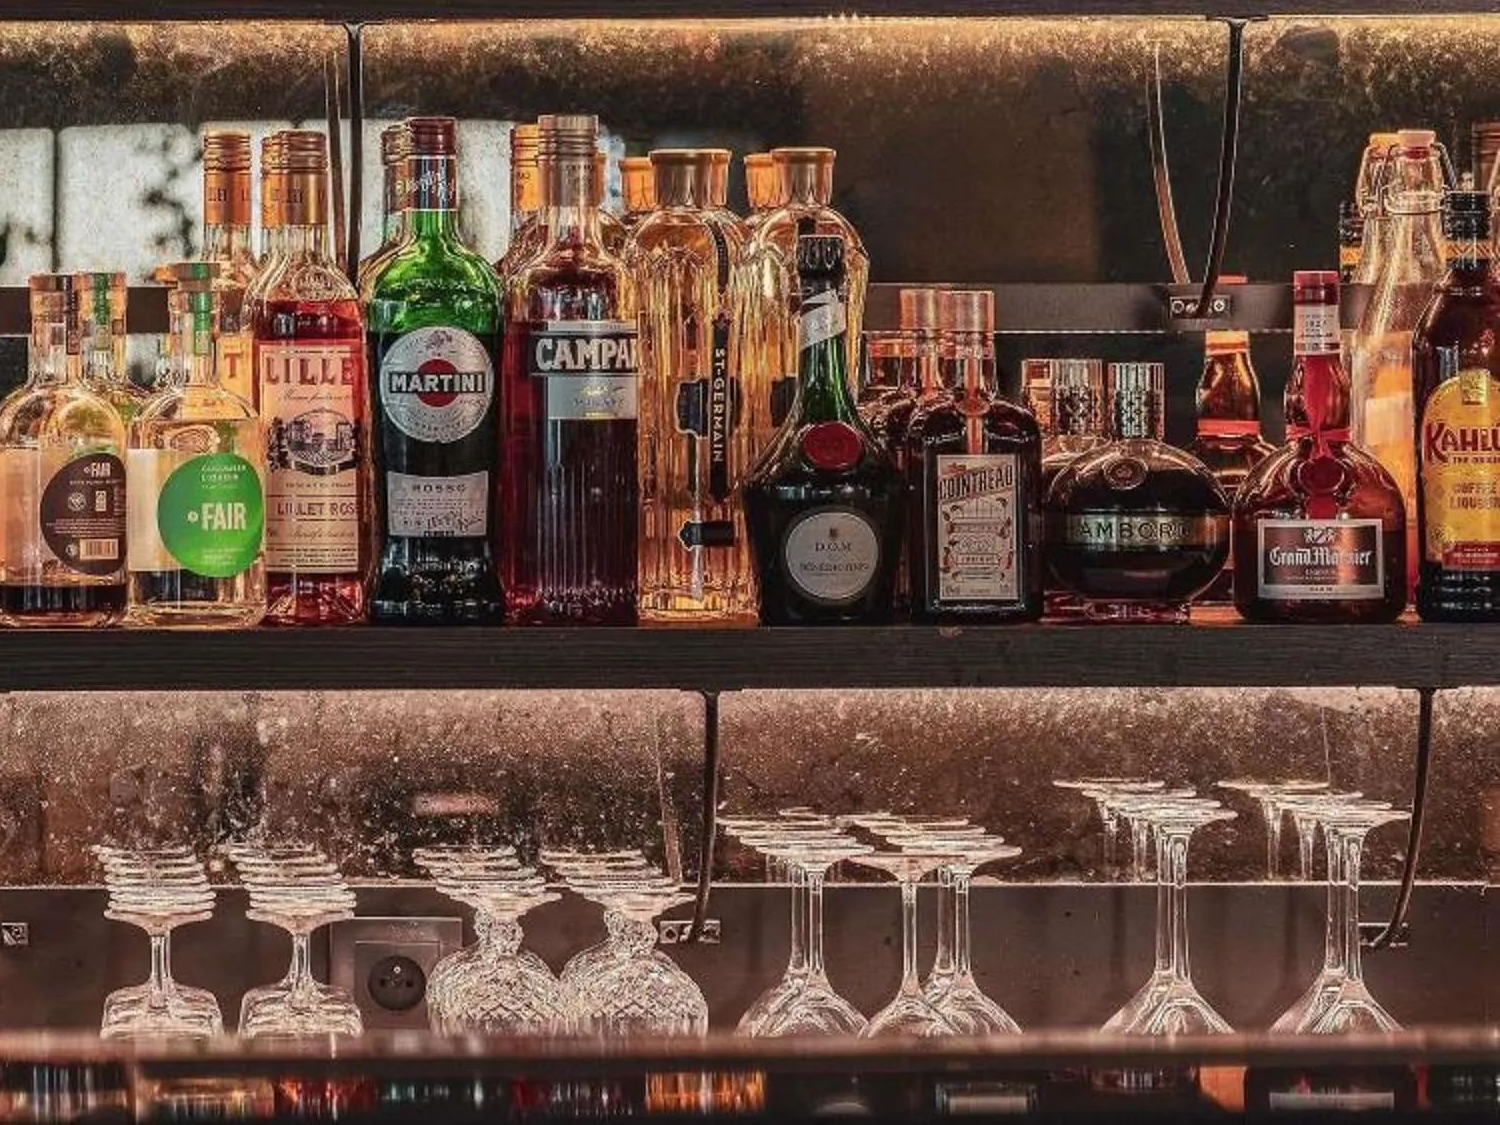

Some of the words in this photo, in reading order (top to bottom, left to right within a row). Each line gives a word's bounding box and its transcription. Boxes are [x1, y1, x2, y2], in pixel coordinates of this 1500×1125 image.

[390, 373, 484, 393] MARTINI
[713, 348, 728, 464] ST-GERMAIN
[91, 462, 112, 477] FAIR
[411, 483, 468, 493] ROSSO
[938, 463, 1014, 501] COINTREAU
[201, 503, 247, 531] FAIR
[276, 503, 324, 516] LILLET
[1269, 546, 1311, 566] Grand
